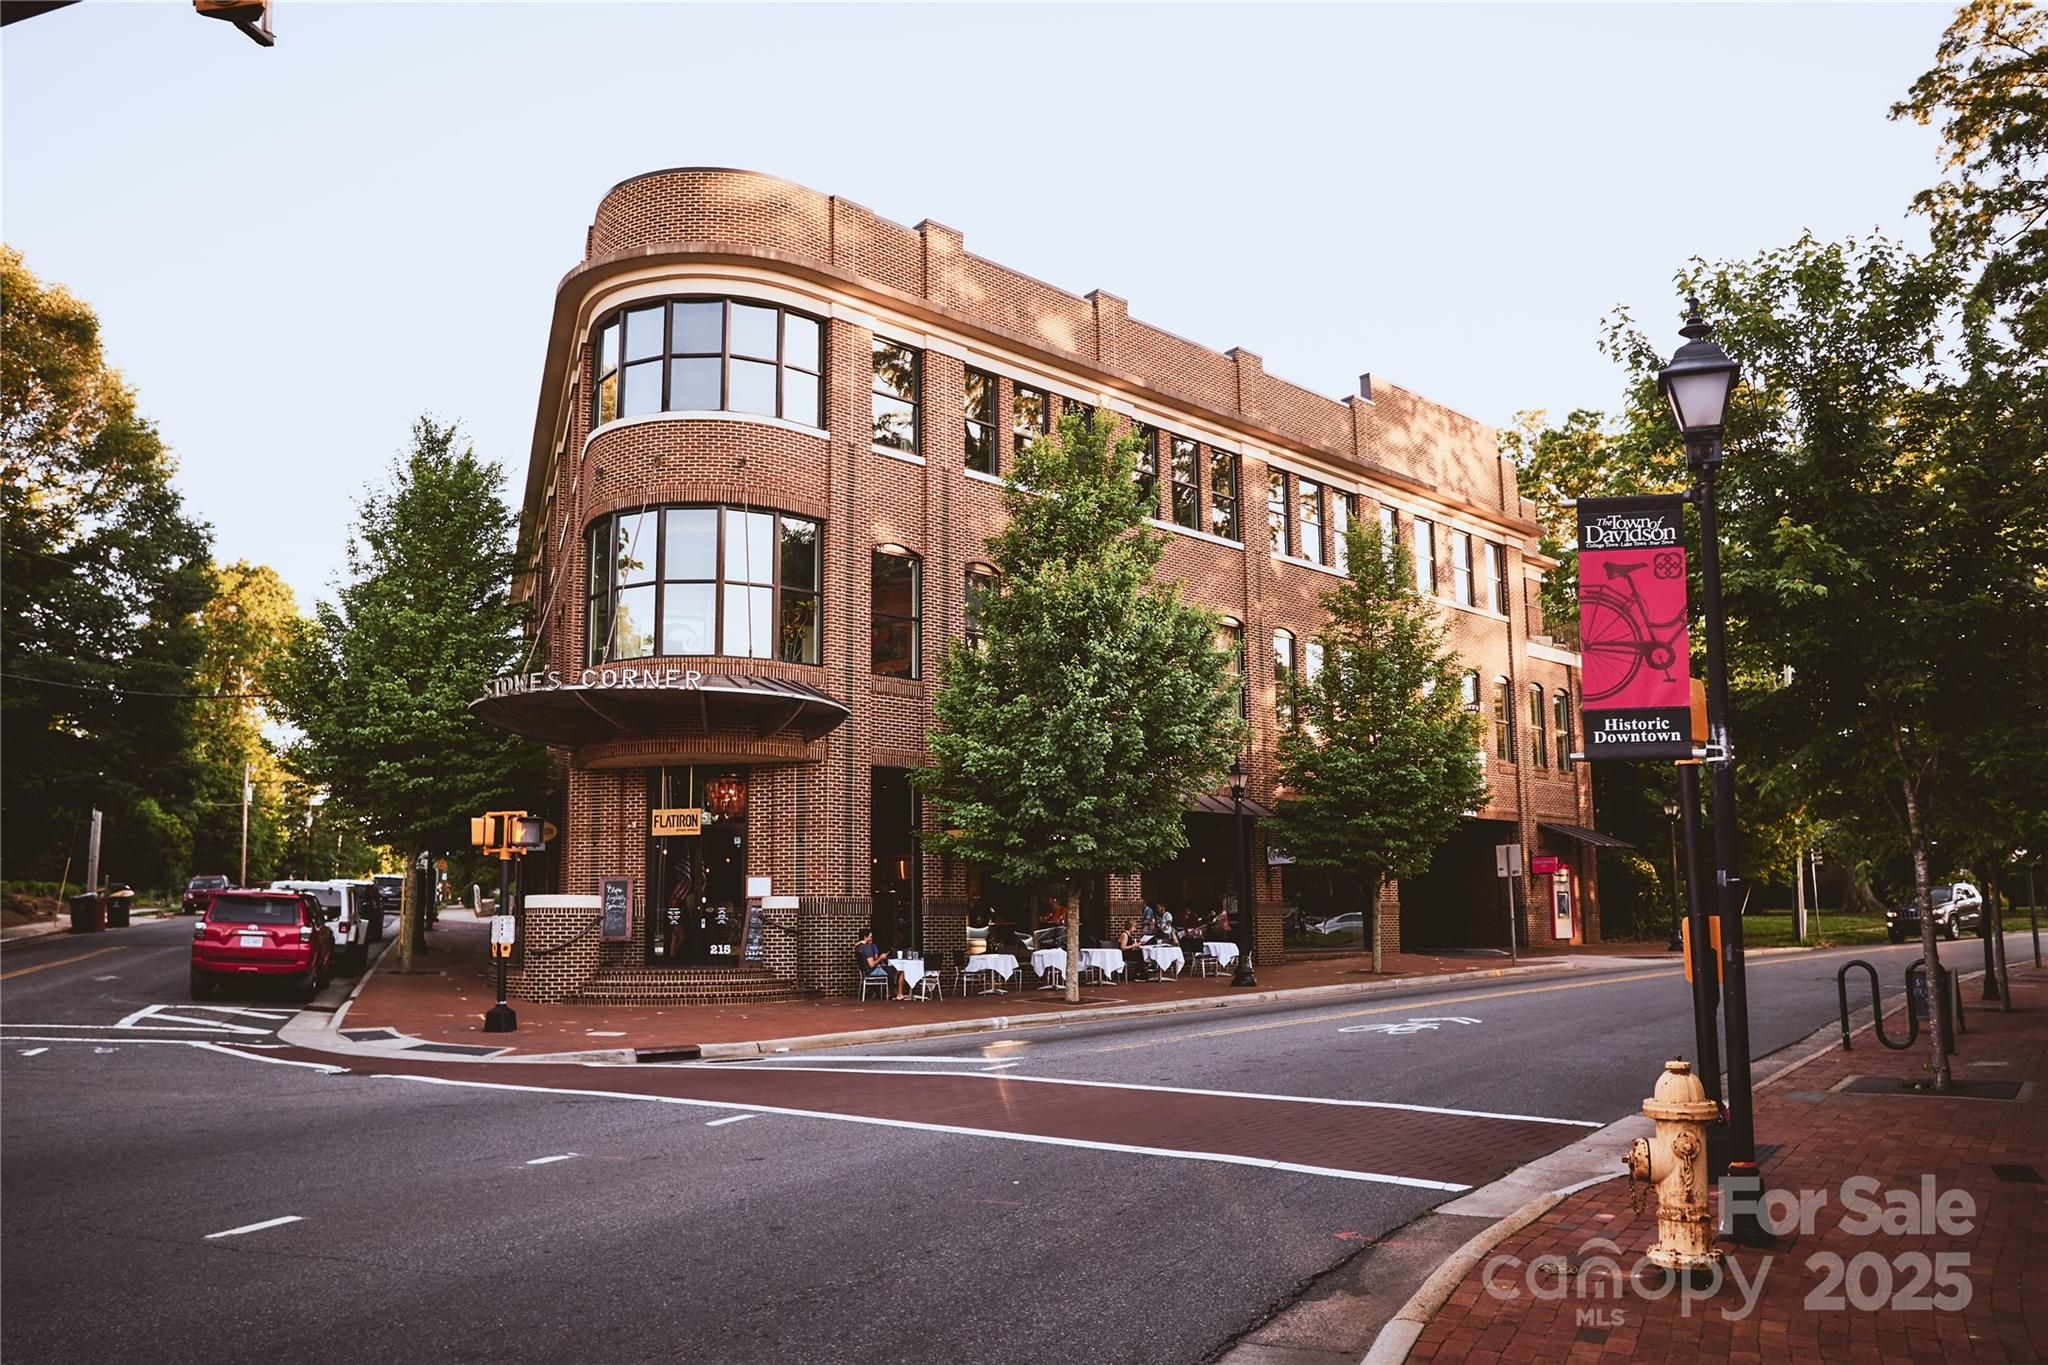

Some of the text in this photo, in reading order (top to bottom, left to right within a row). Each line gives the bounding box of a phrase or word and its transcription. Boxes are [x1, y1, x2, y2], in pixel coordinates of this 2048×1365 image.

[1596, 514, 1665, 532] The Town of
[1584, 525, 1677, 544] Davidson
[481, 664, 702, 698] STOWE'S CORNER
[1604, 717, 1670, 731] Historic
[1593, 731, 1682, 744] Downtown
[653, 814, 698, 829] FLATIRON
[709, 944, 731, 955] 215
